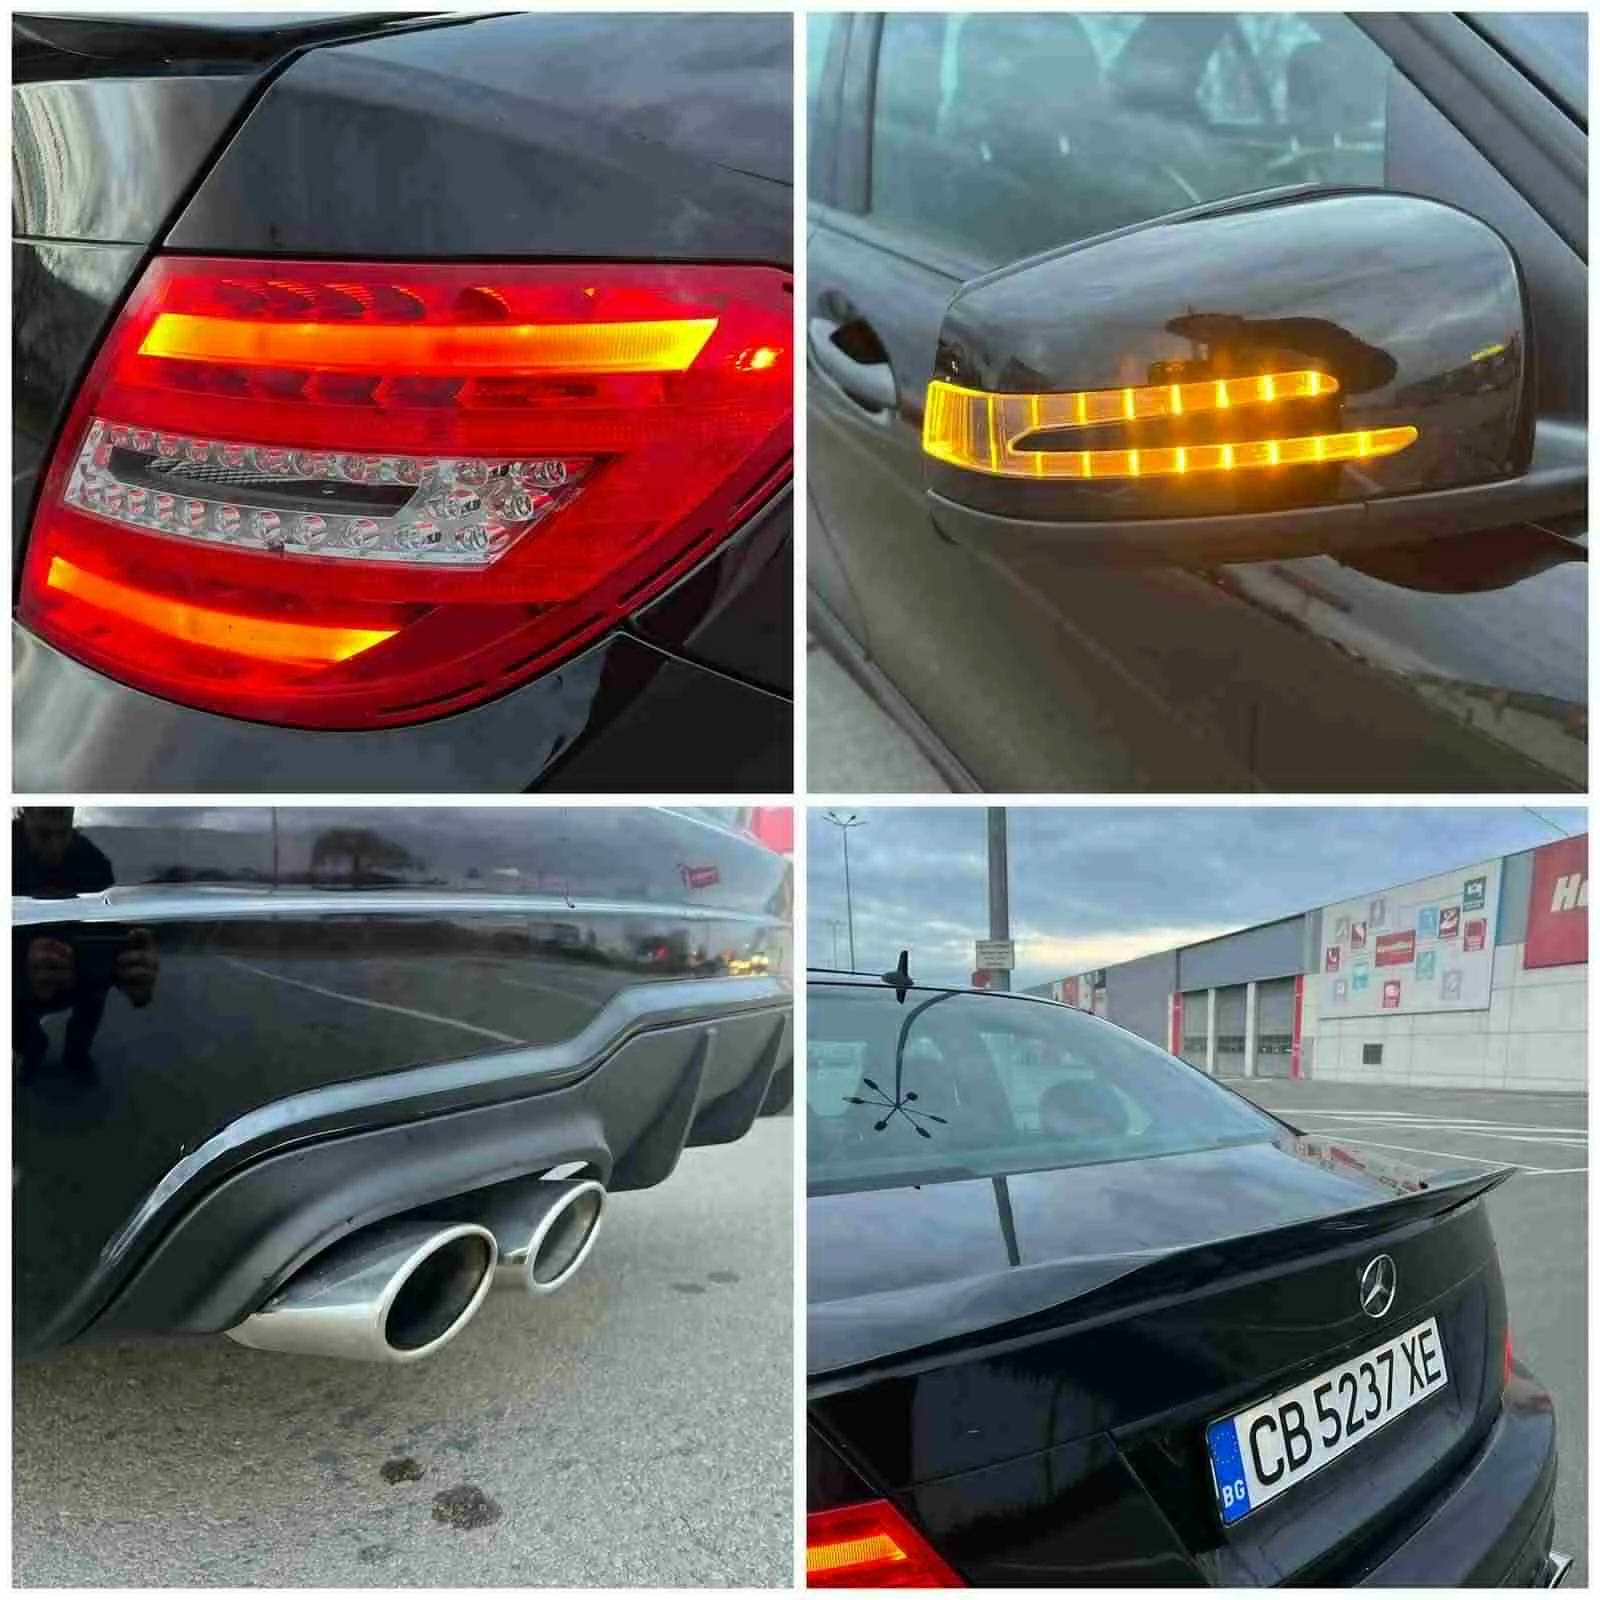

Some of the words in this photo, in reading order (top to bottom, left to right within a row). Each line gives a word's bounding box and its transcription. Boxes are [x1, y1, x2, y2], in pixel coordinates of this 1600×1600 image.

[1249, 1401, 1312, 1486] CB
[1313, 1349, 1394, 1448] 5237
[1400, 1328, 1441, 1396] XE
[1222, 1479, 1246, 1508] BG
